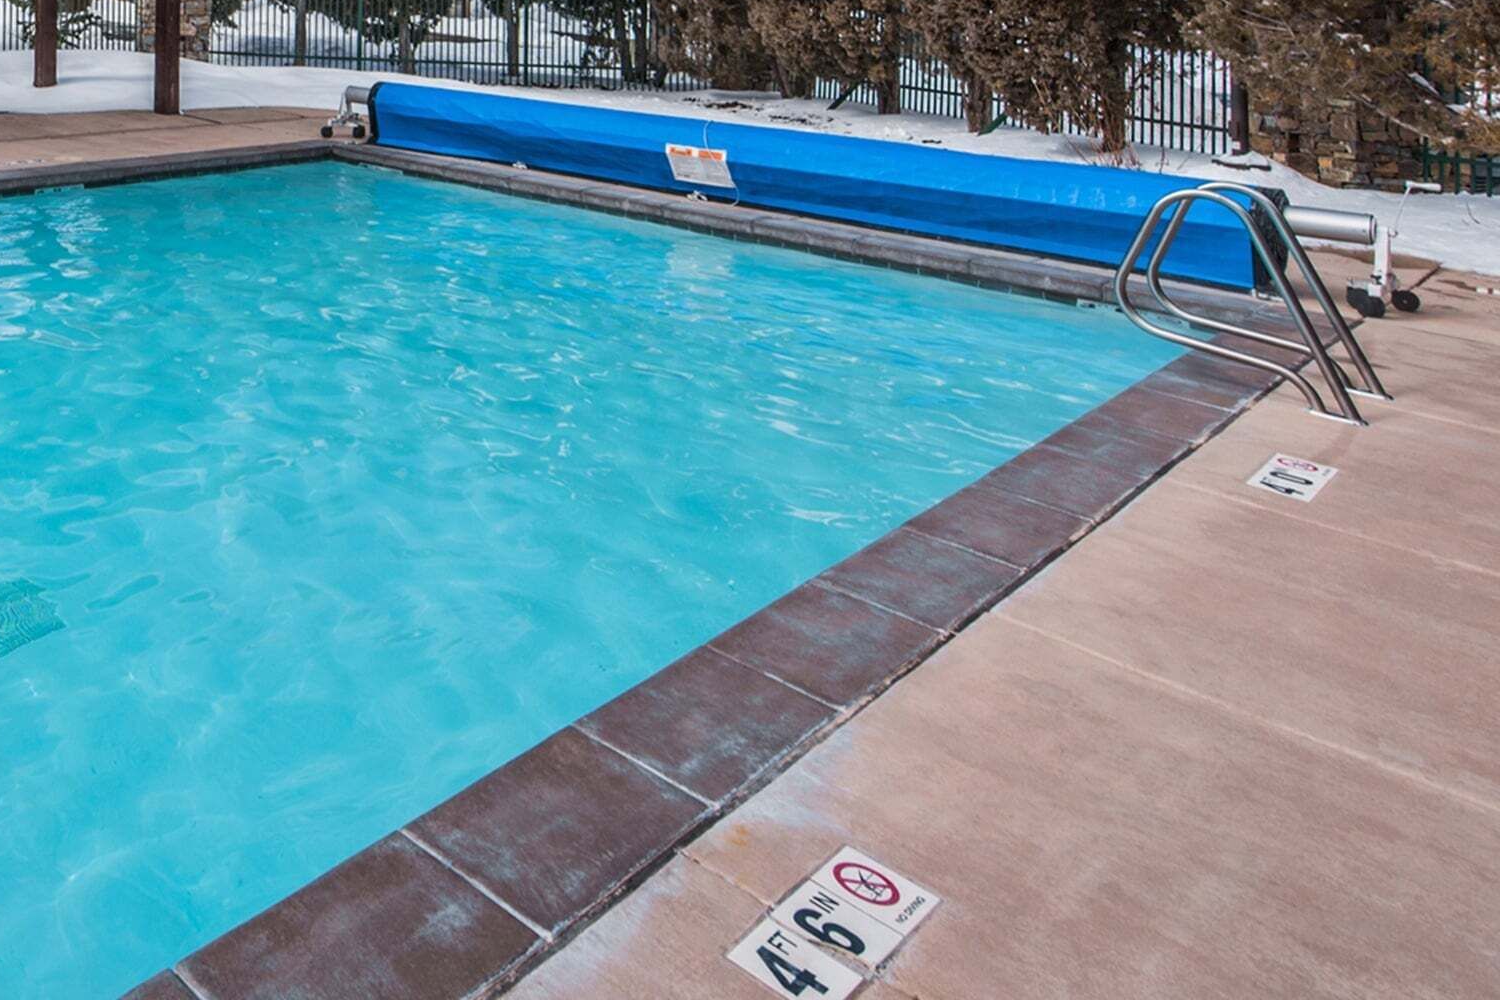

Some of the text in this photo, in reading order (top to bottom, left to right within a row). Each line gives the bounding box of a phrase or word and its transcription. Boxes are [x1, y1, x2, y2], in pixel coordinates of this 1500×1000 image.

[756, 892, 865, 996] 4 FT 6 IN
